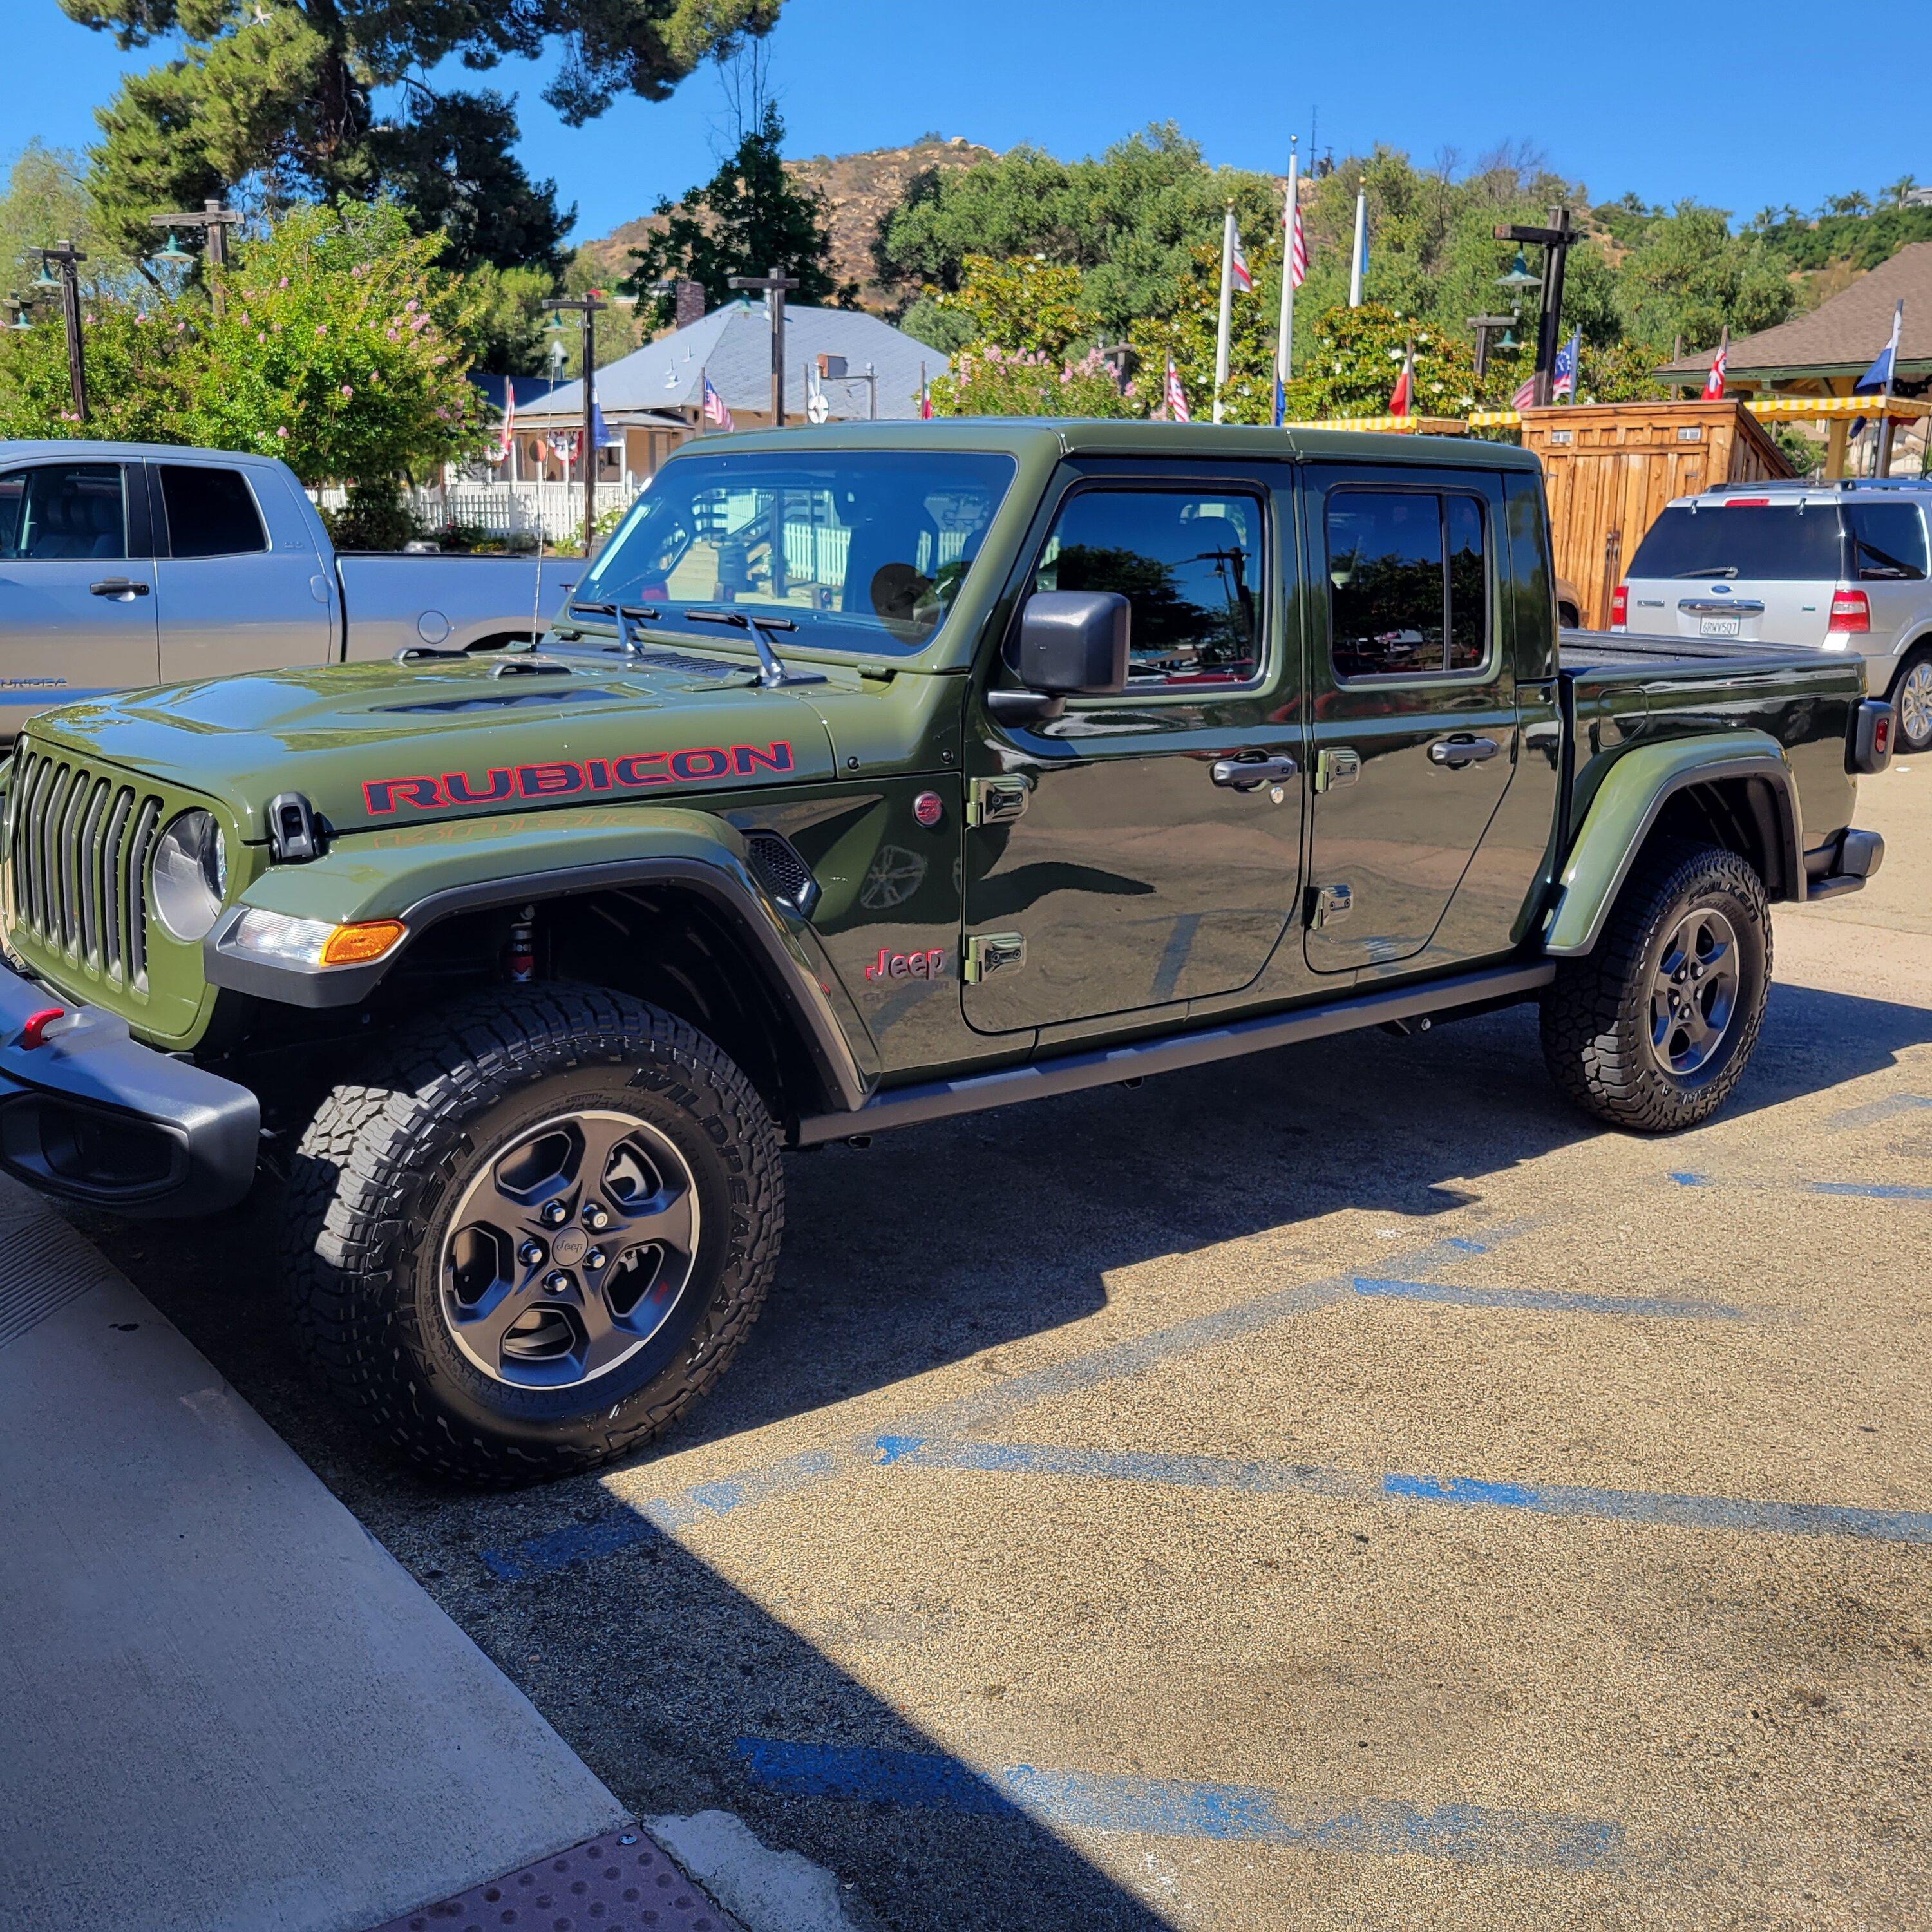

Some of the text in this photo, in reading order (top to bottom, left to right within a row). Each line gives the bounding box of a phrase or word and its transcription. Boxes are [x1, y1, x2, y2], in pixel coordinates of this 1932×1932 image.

[363, 741, 793, 815] RUBICON
[864, 948, 947, 981] Jeep
[556, 1240, 583, 1254] Jeep
